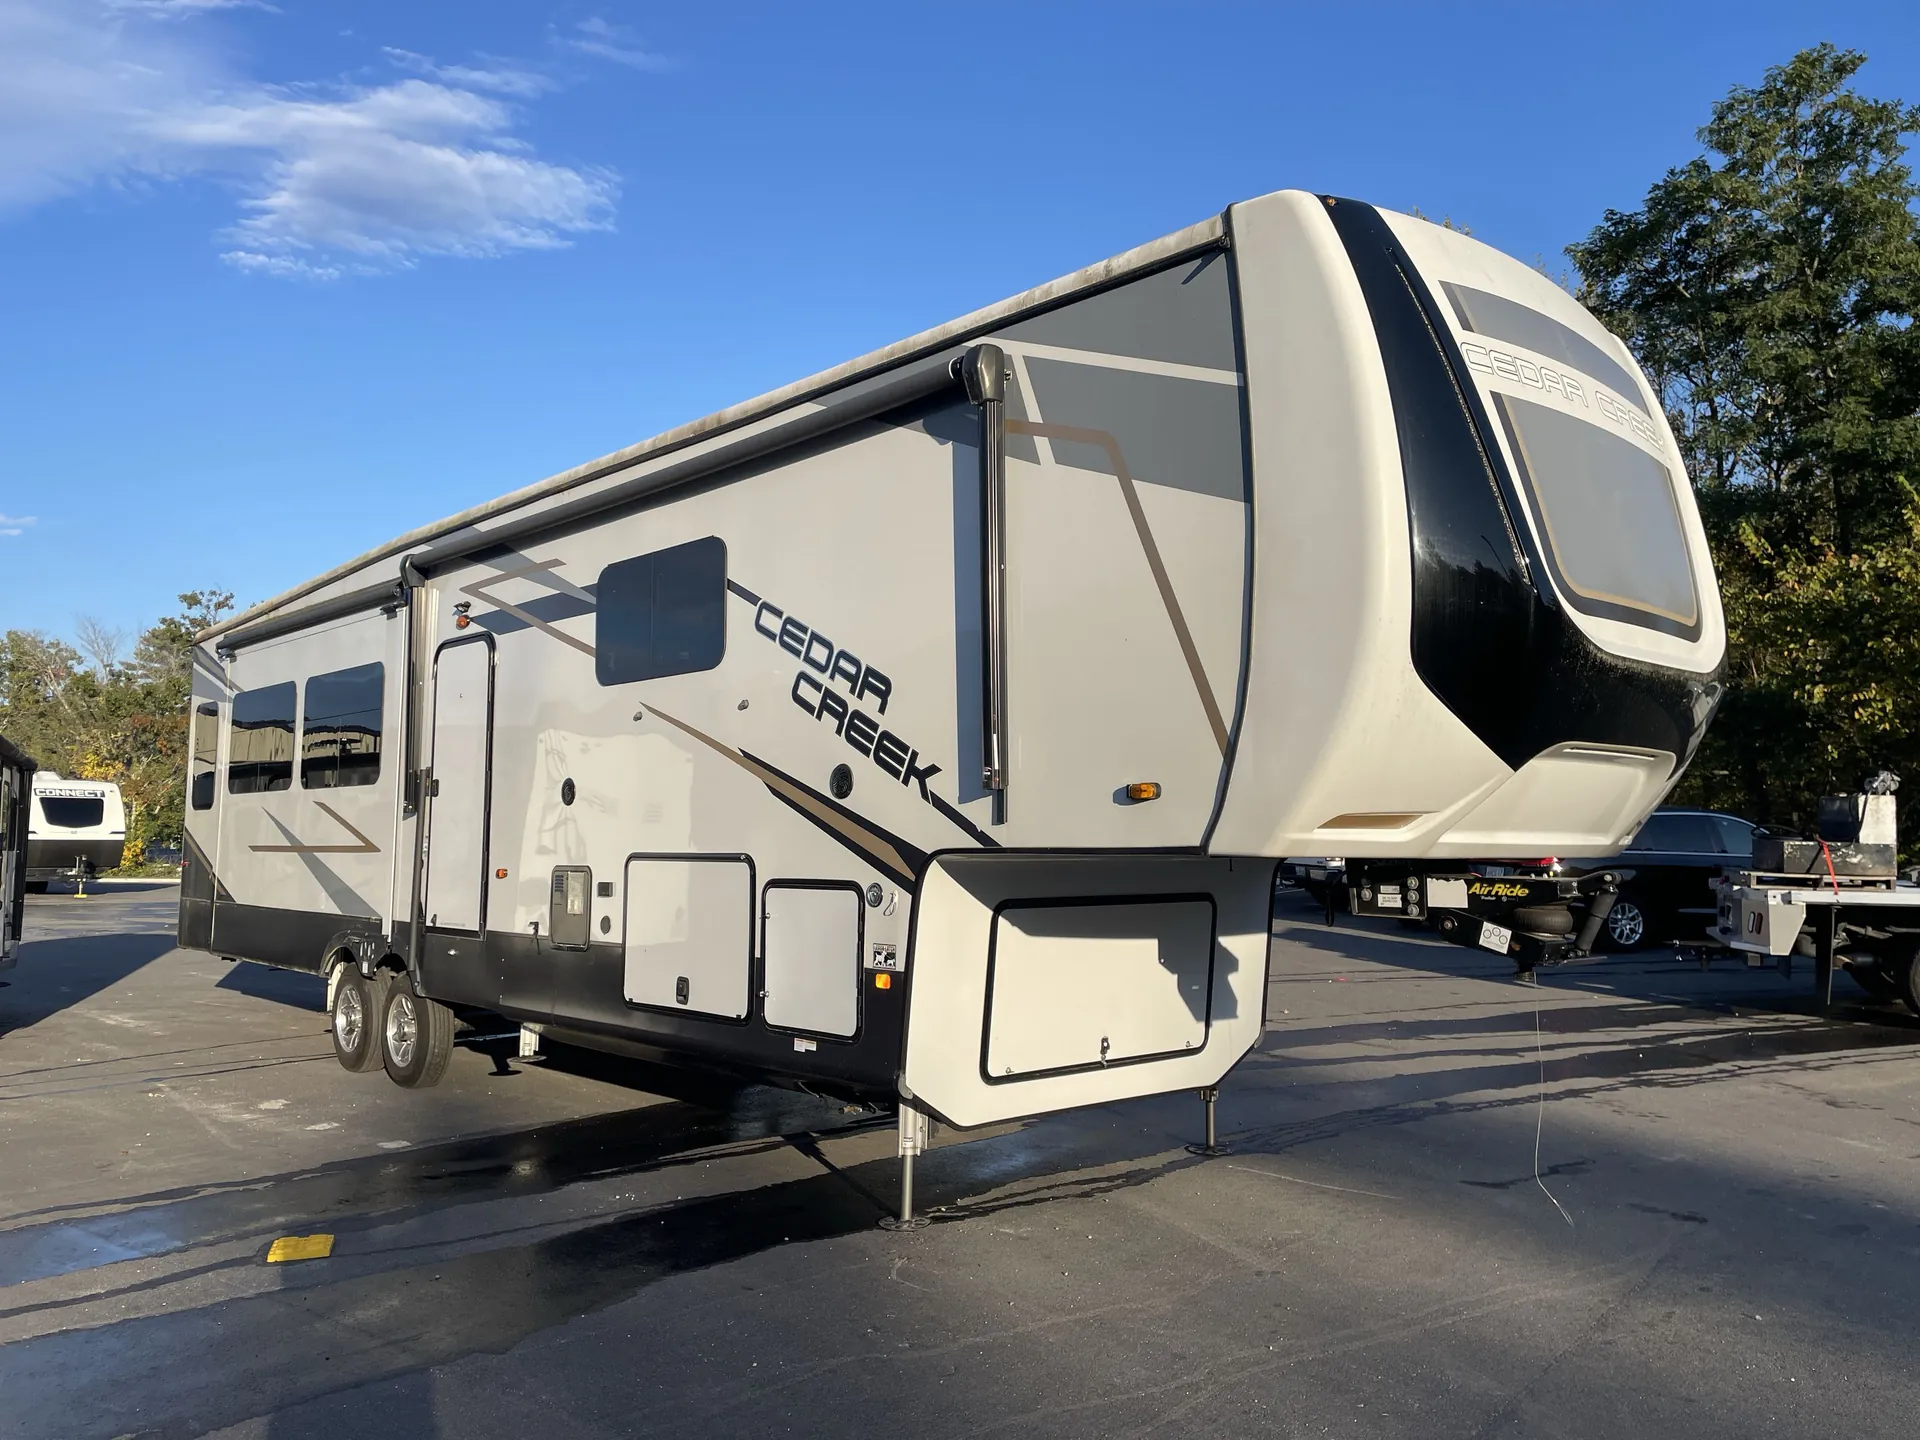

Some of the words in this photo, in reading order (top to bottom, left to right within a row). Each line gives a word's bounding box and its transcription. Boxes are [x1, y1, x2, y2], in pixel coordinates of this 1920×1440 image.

[1460, 341, 1589, 408] CEDAR
[754, 600, 893, 716] CEDAR
[791, 670, 943, 805] CREEK
[35, 788, 104, 797] CONNECT
